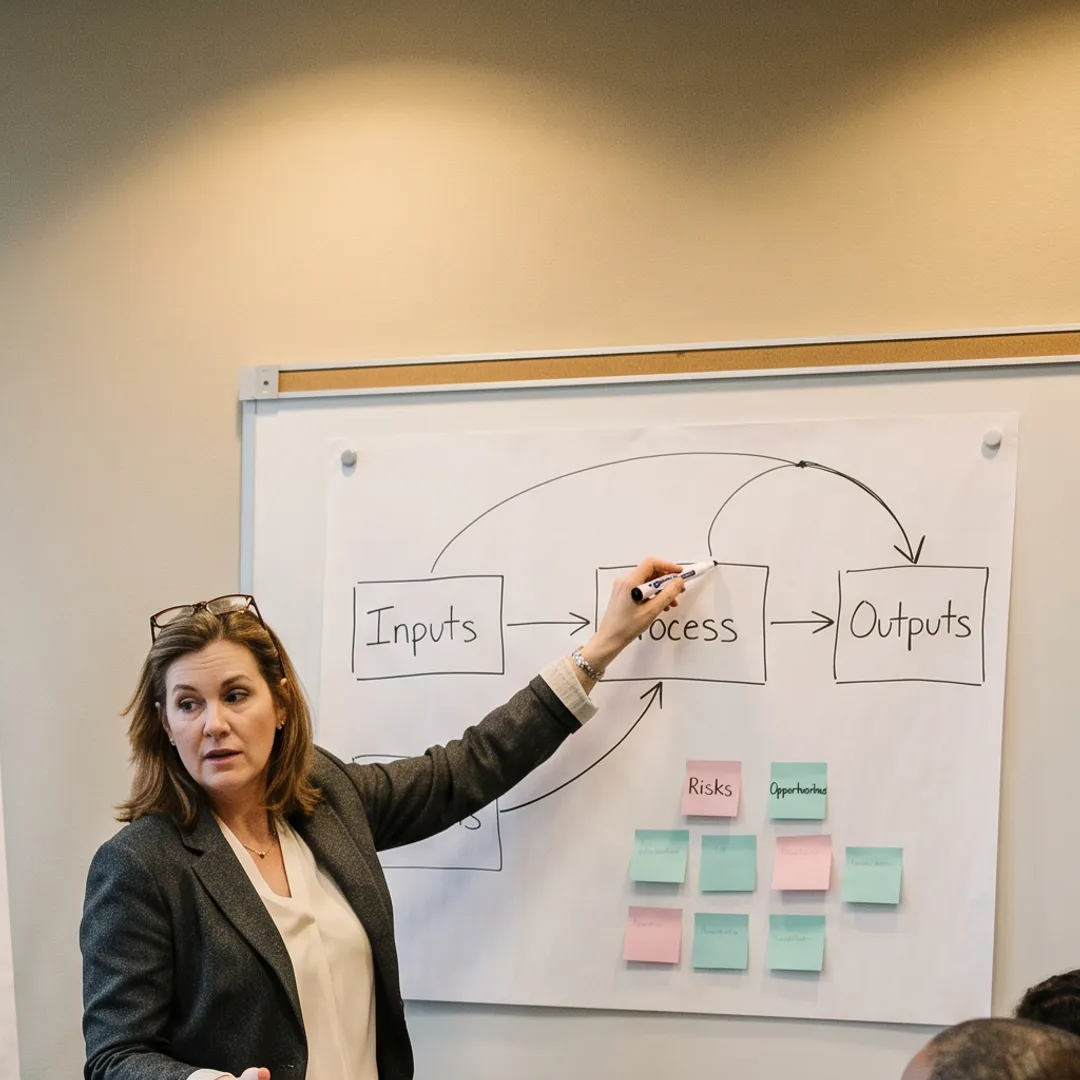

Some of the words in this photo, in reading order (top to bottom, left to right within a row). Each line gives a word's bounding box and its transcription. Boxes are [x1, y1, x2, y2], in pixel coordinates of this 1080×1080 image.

[365, 605, 478, 657] Inputs
[638, 617, 738, 643] ocess
[849, 599, 972, 652] Outputs
[688, 776, 733, 798] Risks
